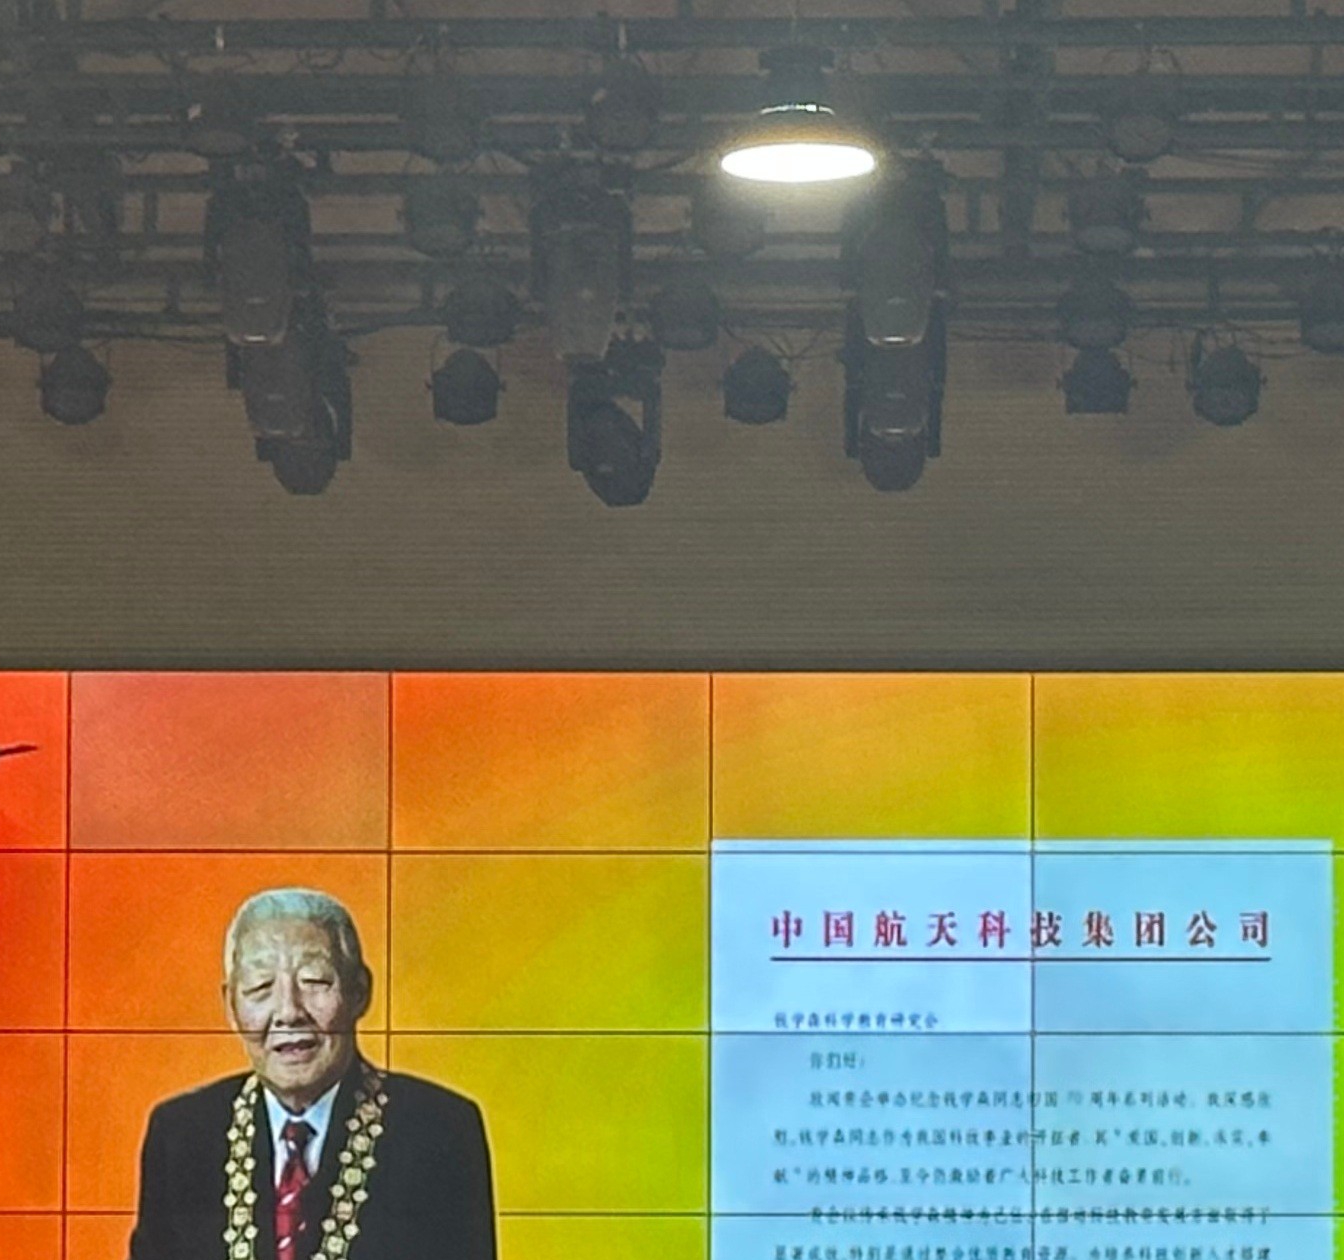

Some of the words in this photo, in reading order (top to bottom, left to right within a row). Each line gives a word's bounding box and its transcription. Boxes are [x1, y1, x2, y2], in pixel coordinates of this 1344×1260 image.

[771, 910, 1269, 948] 中国航天科技集团公司
